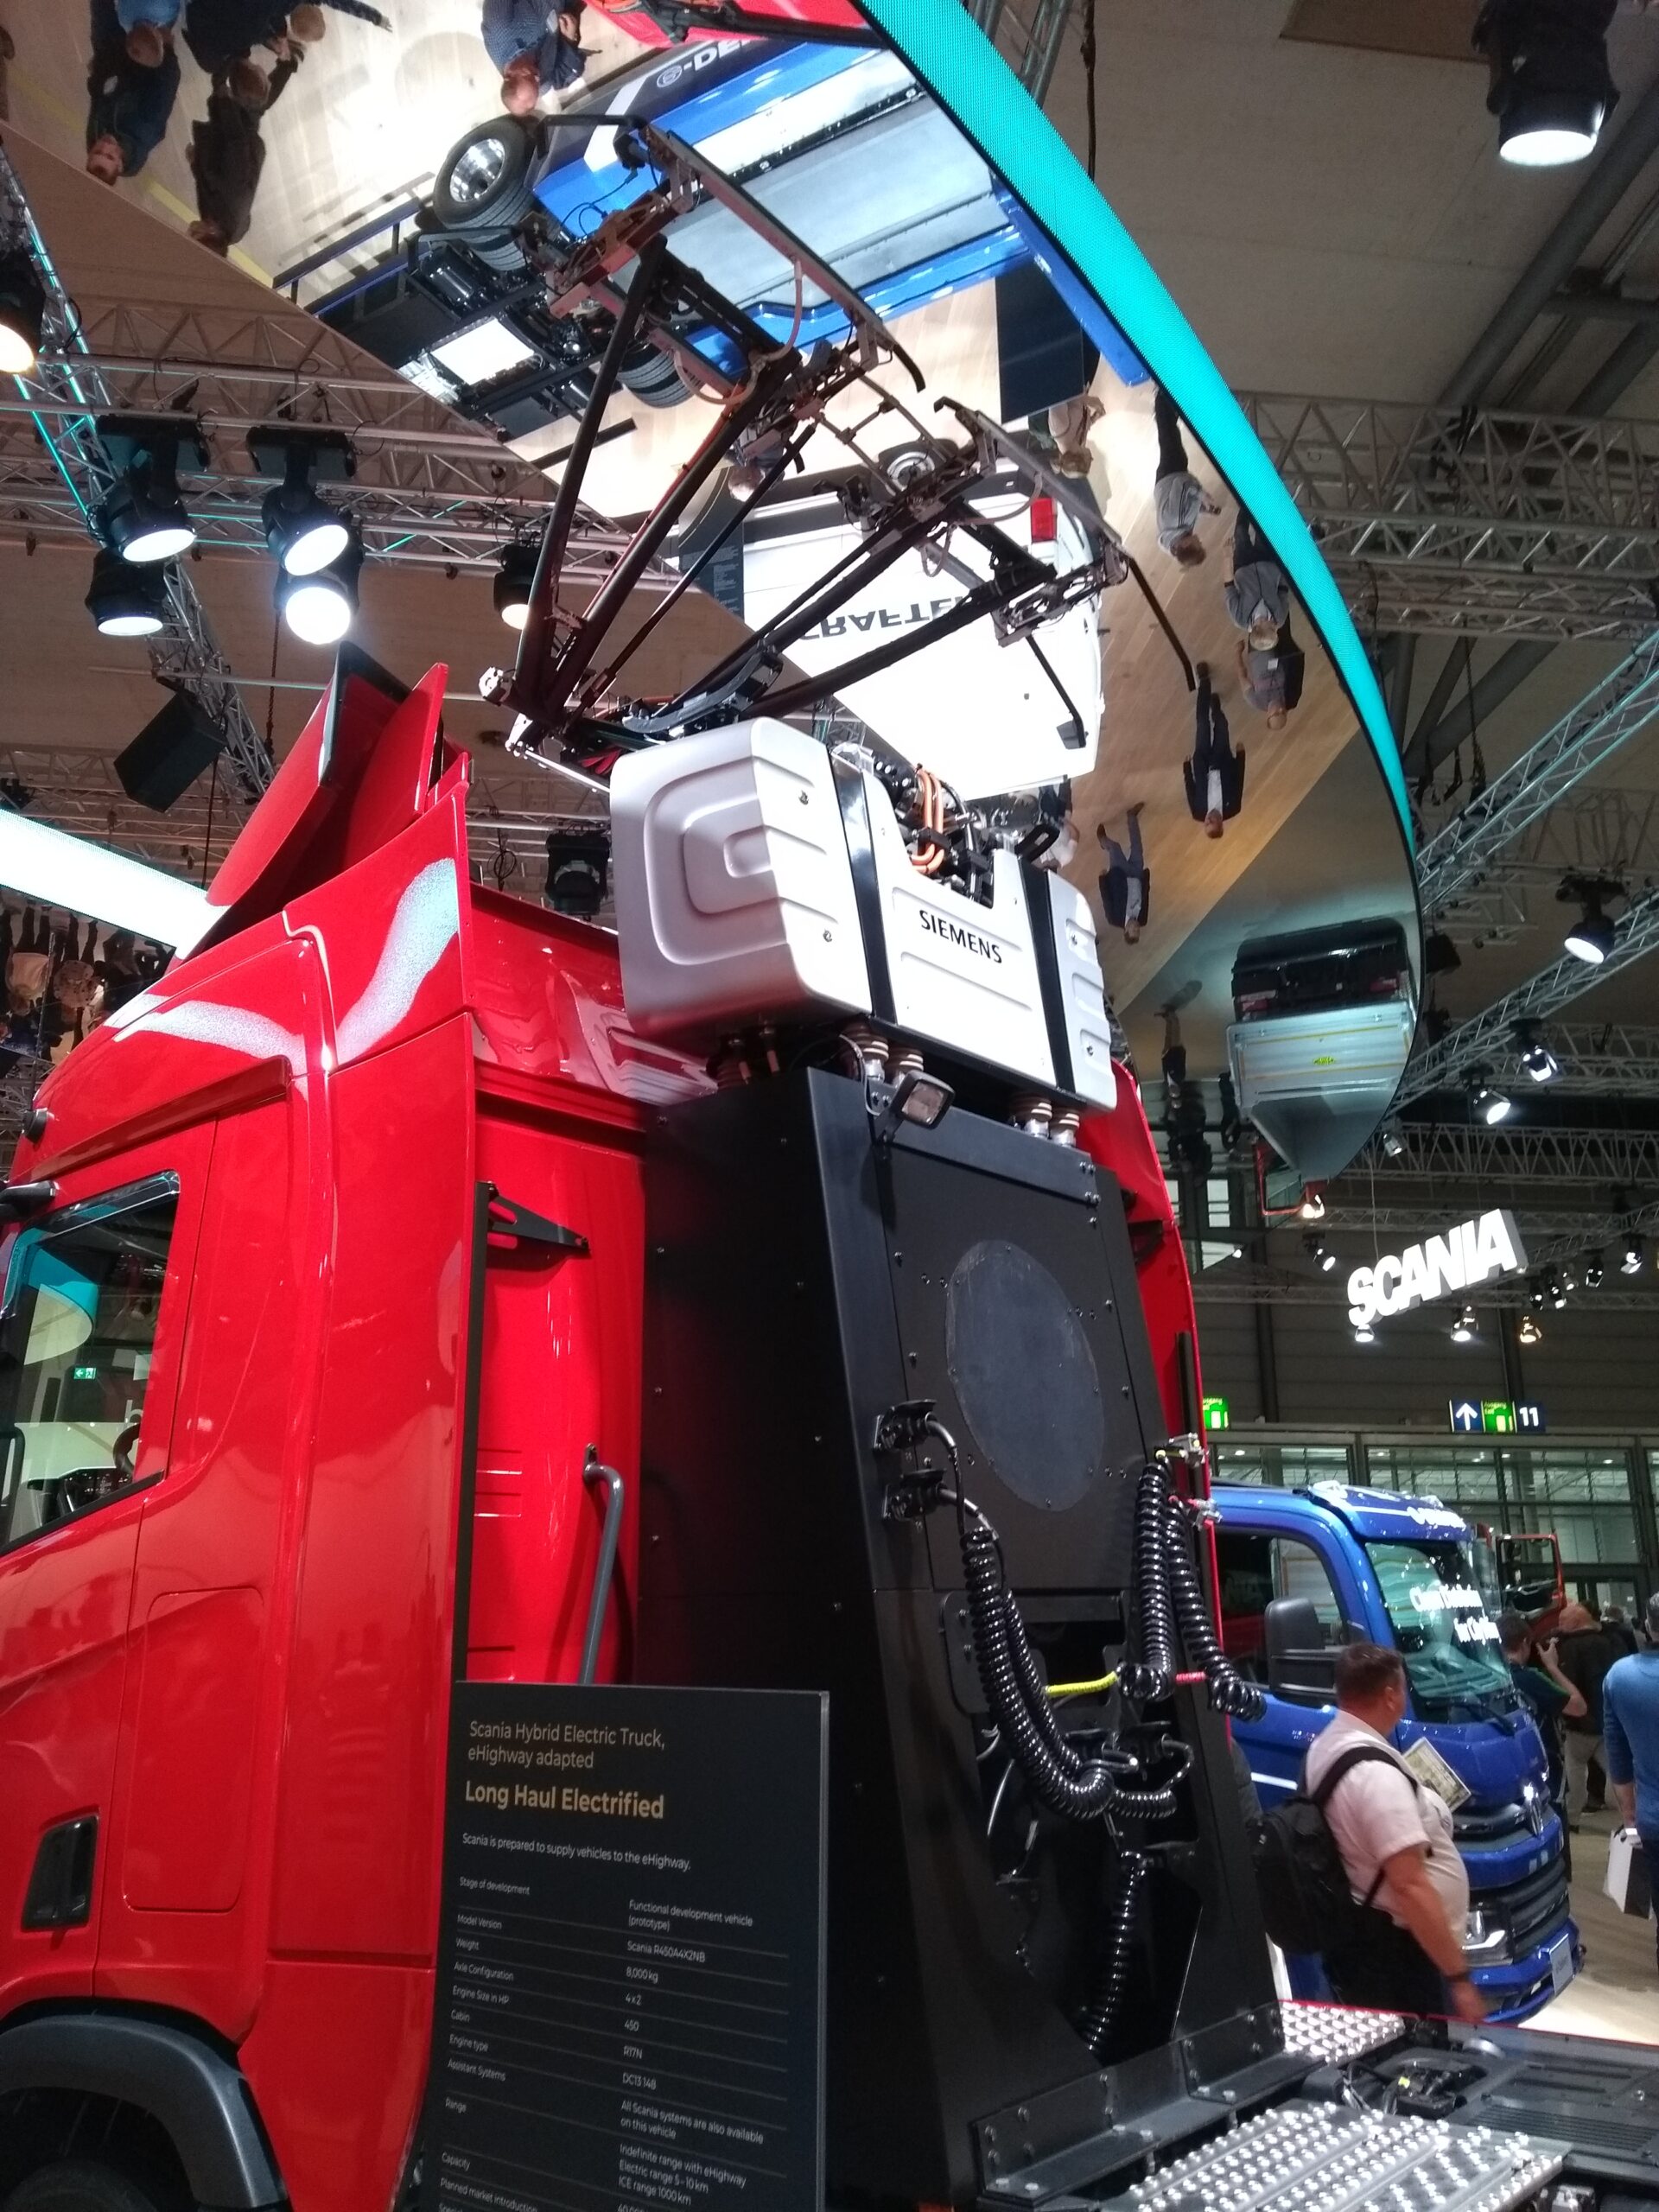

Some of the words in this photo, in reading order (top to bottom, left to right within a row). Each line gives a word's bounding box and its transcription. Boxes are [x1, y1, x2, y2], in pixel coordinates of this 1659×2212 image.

[919, 909, 1002, 964] SIEMENS
[1347, 1208, 1521, 1327] SCANIA
[1519, 1407, 1539, 1427] 11
[470, 1721, 511, 1739] Scania
[516, 1724, 559, 1744] Hybrid
[564, 1726, 616, 1745] Electric
[620, 1727, 664, 1750] Truck,
[468, 1745, 533, 1768] eHighway
[537, 1749, 594, 1770] adapted
[466, 1781, 509, 1809] Long
[515, 1784, 556, 1809] Haul
[562, 1788, 664, 1819] Electrified
[462, 1833, 488, 1846] Scania
[490, 1835, 496, 1847] is
[498, 1838, 535, 1852] prepared
[537, 1842, 545, 1853] to
[547, 1844, 575, 1859] supply
[576, 1847, 612, 1860] vehicles
[613, 1851, 623, 1862] to
[625, 1852, 640, 1864] the
[641, 1853, 691, 1872] eHighway.
[460, 1876, 478, 1889] Stage
[479, 1878, 486, 1889] of
[486, 1880, 531, 1895] development
[457, 1914, 477, 1925] Model
[479, 1916, 502, 1929] Version
[628, 1915, 671, 1932] (prototype)
[629, 1899, 670, 1915] Functional
[671, 1905, 722, 1923] development
[724, 1913, 753, 1927] vehicle
[456, 1937, 480, 1951] Weight
[627, 1941, 652, 1954] Scania
[454, 1961, 467, 1972] Axle
[468, 1964, 514, 1980] Configuration
[626, 1966, 648, 1980] 8,000
[649, 1971, 658, 1984] kg
[453, 1986, 475, 1999] Engine
[476, 1990, 490, 2001] Size
[491, 1993, 497, 2002] in
[499, 1994, 510, 2005] HP
[451, 2010, 470, 2022] Cabin
[624, 2018, 639, 2031] 450
[449, 2034, 473, 2048] Engine
[474, 2040, 489, 2053] type
[448, 2058, 477, 2074] Assistant
[478, 2065, 506, 2082] Systems
[445, 2096, 467, 2113] Range
[620, 2100, 632, 2112] All
[632, 2102, 658, 2119] Scania
[659, 2110, 691, 2126] systems
[693, 2118, 707, 2130] are
[708, 2120, 725, 2135] also
[726, 2126, 764, 2145] available
[620, 2117, 632, 2128] on
[632, 2119, 647, 2133] this
[648, 2124, 677, 2139] vehicle
[442, 2152, 471, 2171] Capacity
[620, 2144, 658, 2163] Indefinite
[658, 2152, 683, 2171] range
[683, 2161, 702, 2175] with
[704, 2164, 747, 2189] eHighway
[619, 2159, 648, 2177] Electric
[649, 2169, 673, 2185] range
[695, 2179, 709, 2194] km
[440, 2177, 468, 2196] Planned
[469, 2188, 494, 2203] market
[619, 2176, 632, 2190] ICE
[632, 2181, 657, 2197] range
[658, 2184, 677, 2202] 1000
[678, 2191, 692, 2205] km
